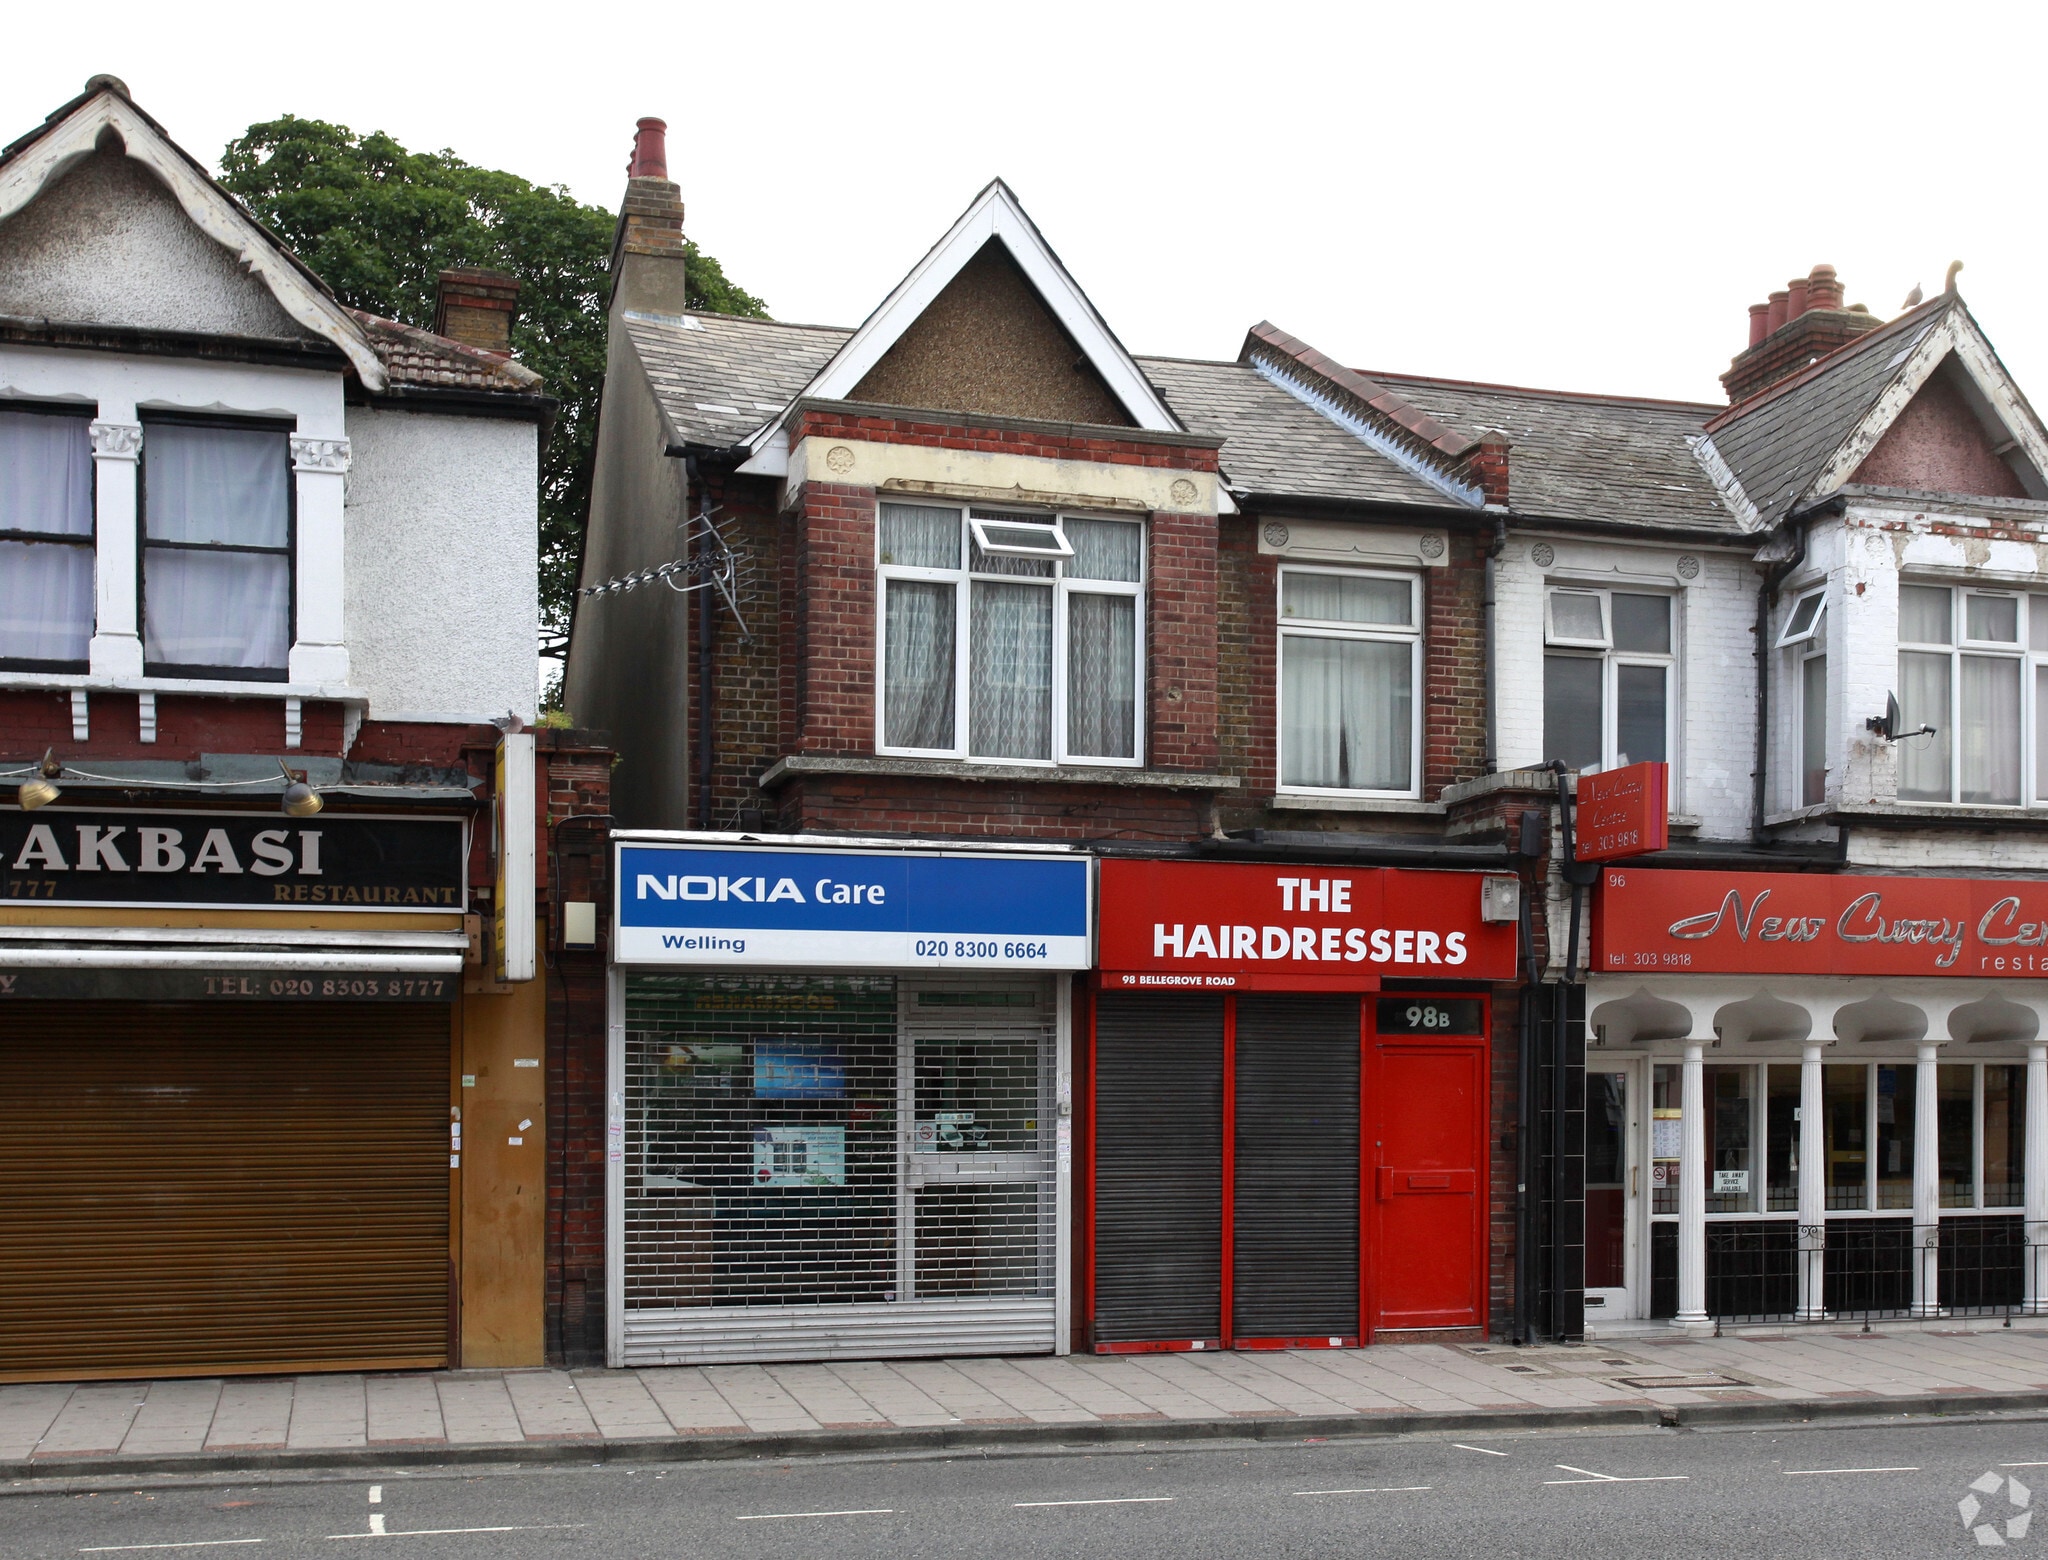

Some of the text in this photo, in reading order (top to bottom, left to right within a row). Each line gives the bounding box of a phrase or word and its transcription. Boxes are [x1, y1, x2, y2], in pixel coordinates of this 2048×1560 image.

[1618, 829, 1639, 847] 9818
[0, 823, 323, 876] AKBASI
[637, 874, 885, 905] NOKIA Care
[1609, 874, 1626, 888] 96
[274, 884, 456, 904] RESTAURANT
[1276, 877, 1352, 913] THE
[1667, 888, 1827, 943] New
[1836, 891, 1966, 968] Curry
[662, 934, 746, 954] Welling
[915, 939, 1048, 960] 020 8300 6664
[1153, 923, 1468, 966] HAIRDRESSERS
[1633, 952, 1658, 966] 303
[1662, 953, 1692, 967] 9818
[203, 976, 444, 997] TEL: 020 8303 8777
[1121, 975, 1236, 987] 98 BELLEGROVE ROAD
[1405, 1006, 1450, 1028] 98B
